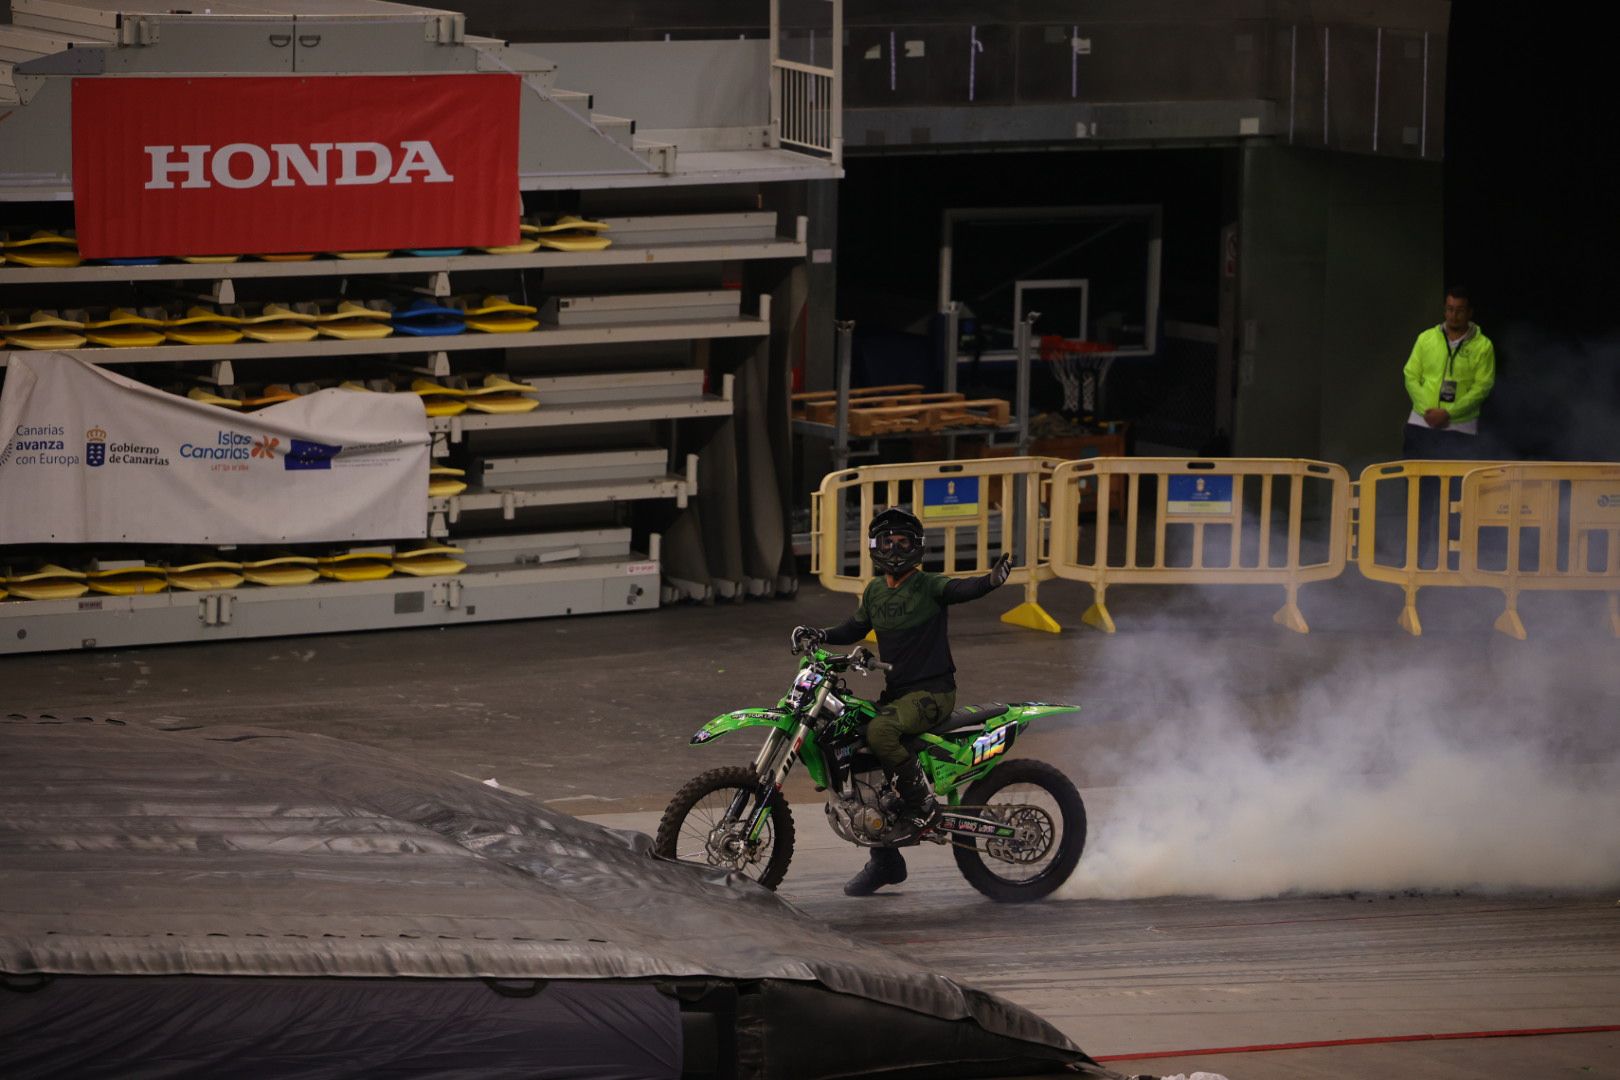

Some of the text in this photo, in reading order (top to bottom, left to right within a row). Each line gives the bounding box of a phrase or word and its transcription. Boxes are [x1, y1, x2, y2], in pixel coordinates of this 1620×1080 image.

[144, 140, 454, 191] HONDA
[16, 424, 64, 436] Canarias
[16, 440, 65, 451] avanza
[217, 431, 252, 446] Islas
[109, 442, 160, 455] Gobierno
[180, 443, 250, 460] Canarias
[15, 453, 80, 468] con Europa
[109, 453, 170, 466] de Canarias
